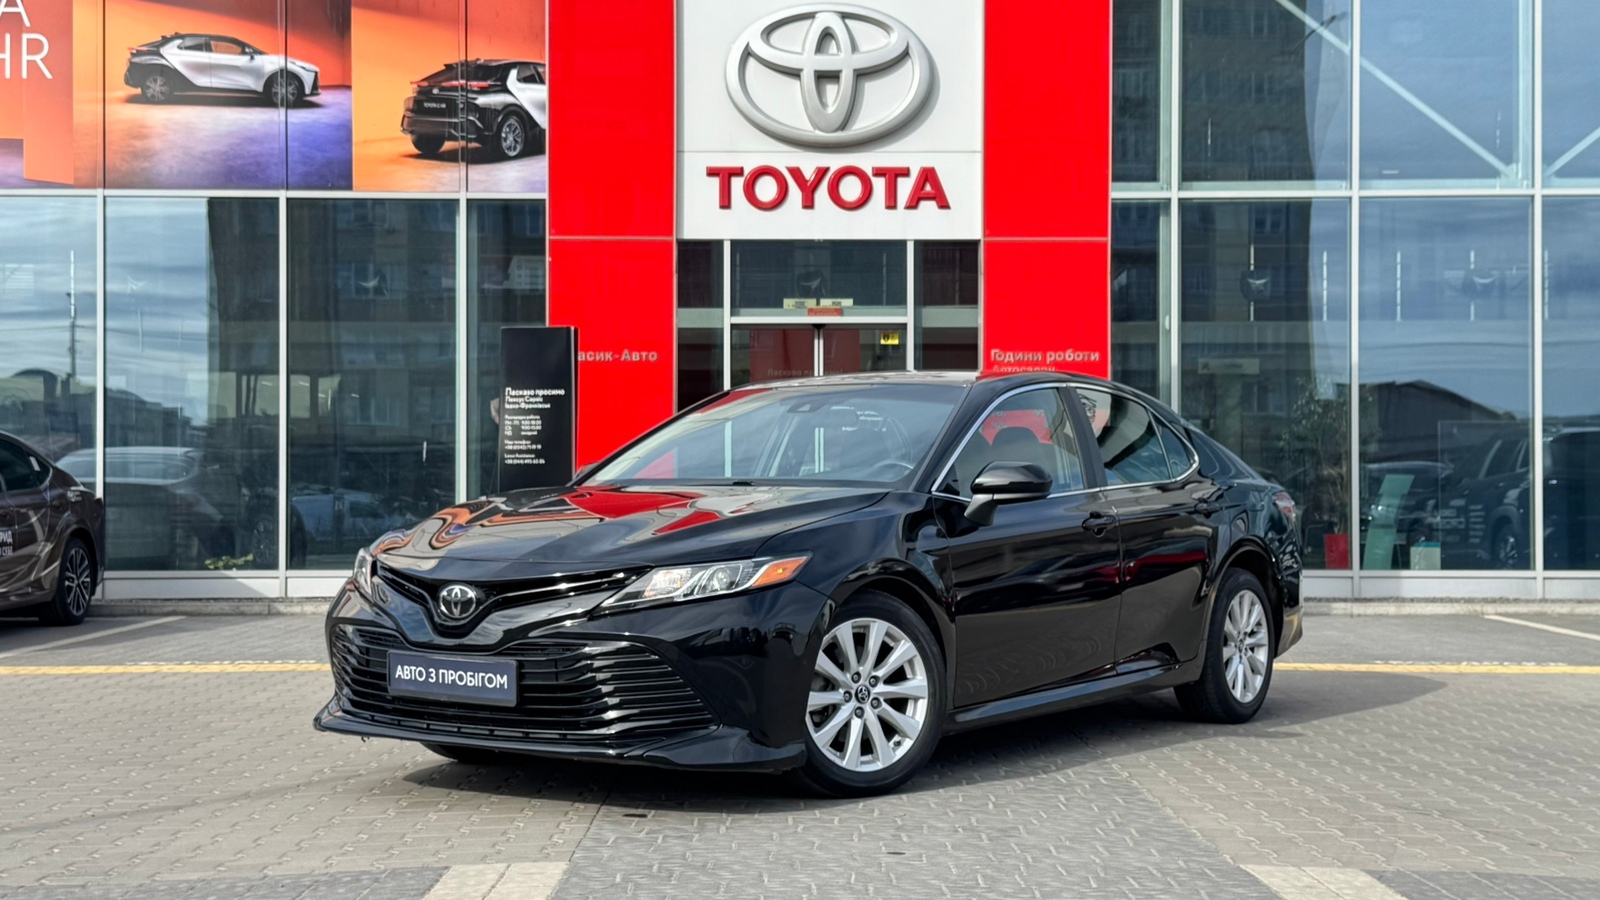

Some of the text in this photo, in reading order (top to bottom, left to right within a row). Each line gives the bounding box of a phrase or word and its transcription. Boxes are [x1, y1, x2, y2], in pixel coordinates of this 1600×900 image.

[706, 165, 951, 211] TOYOTA
[990, 348, 1100, 364] Години роботи
[395, 664, 426, 682] АВТО
[439, 669, 508, 689] ПРОБІГОМ
